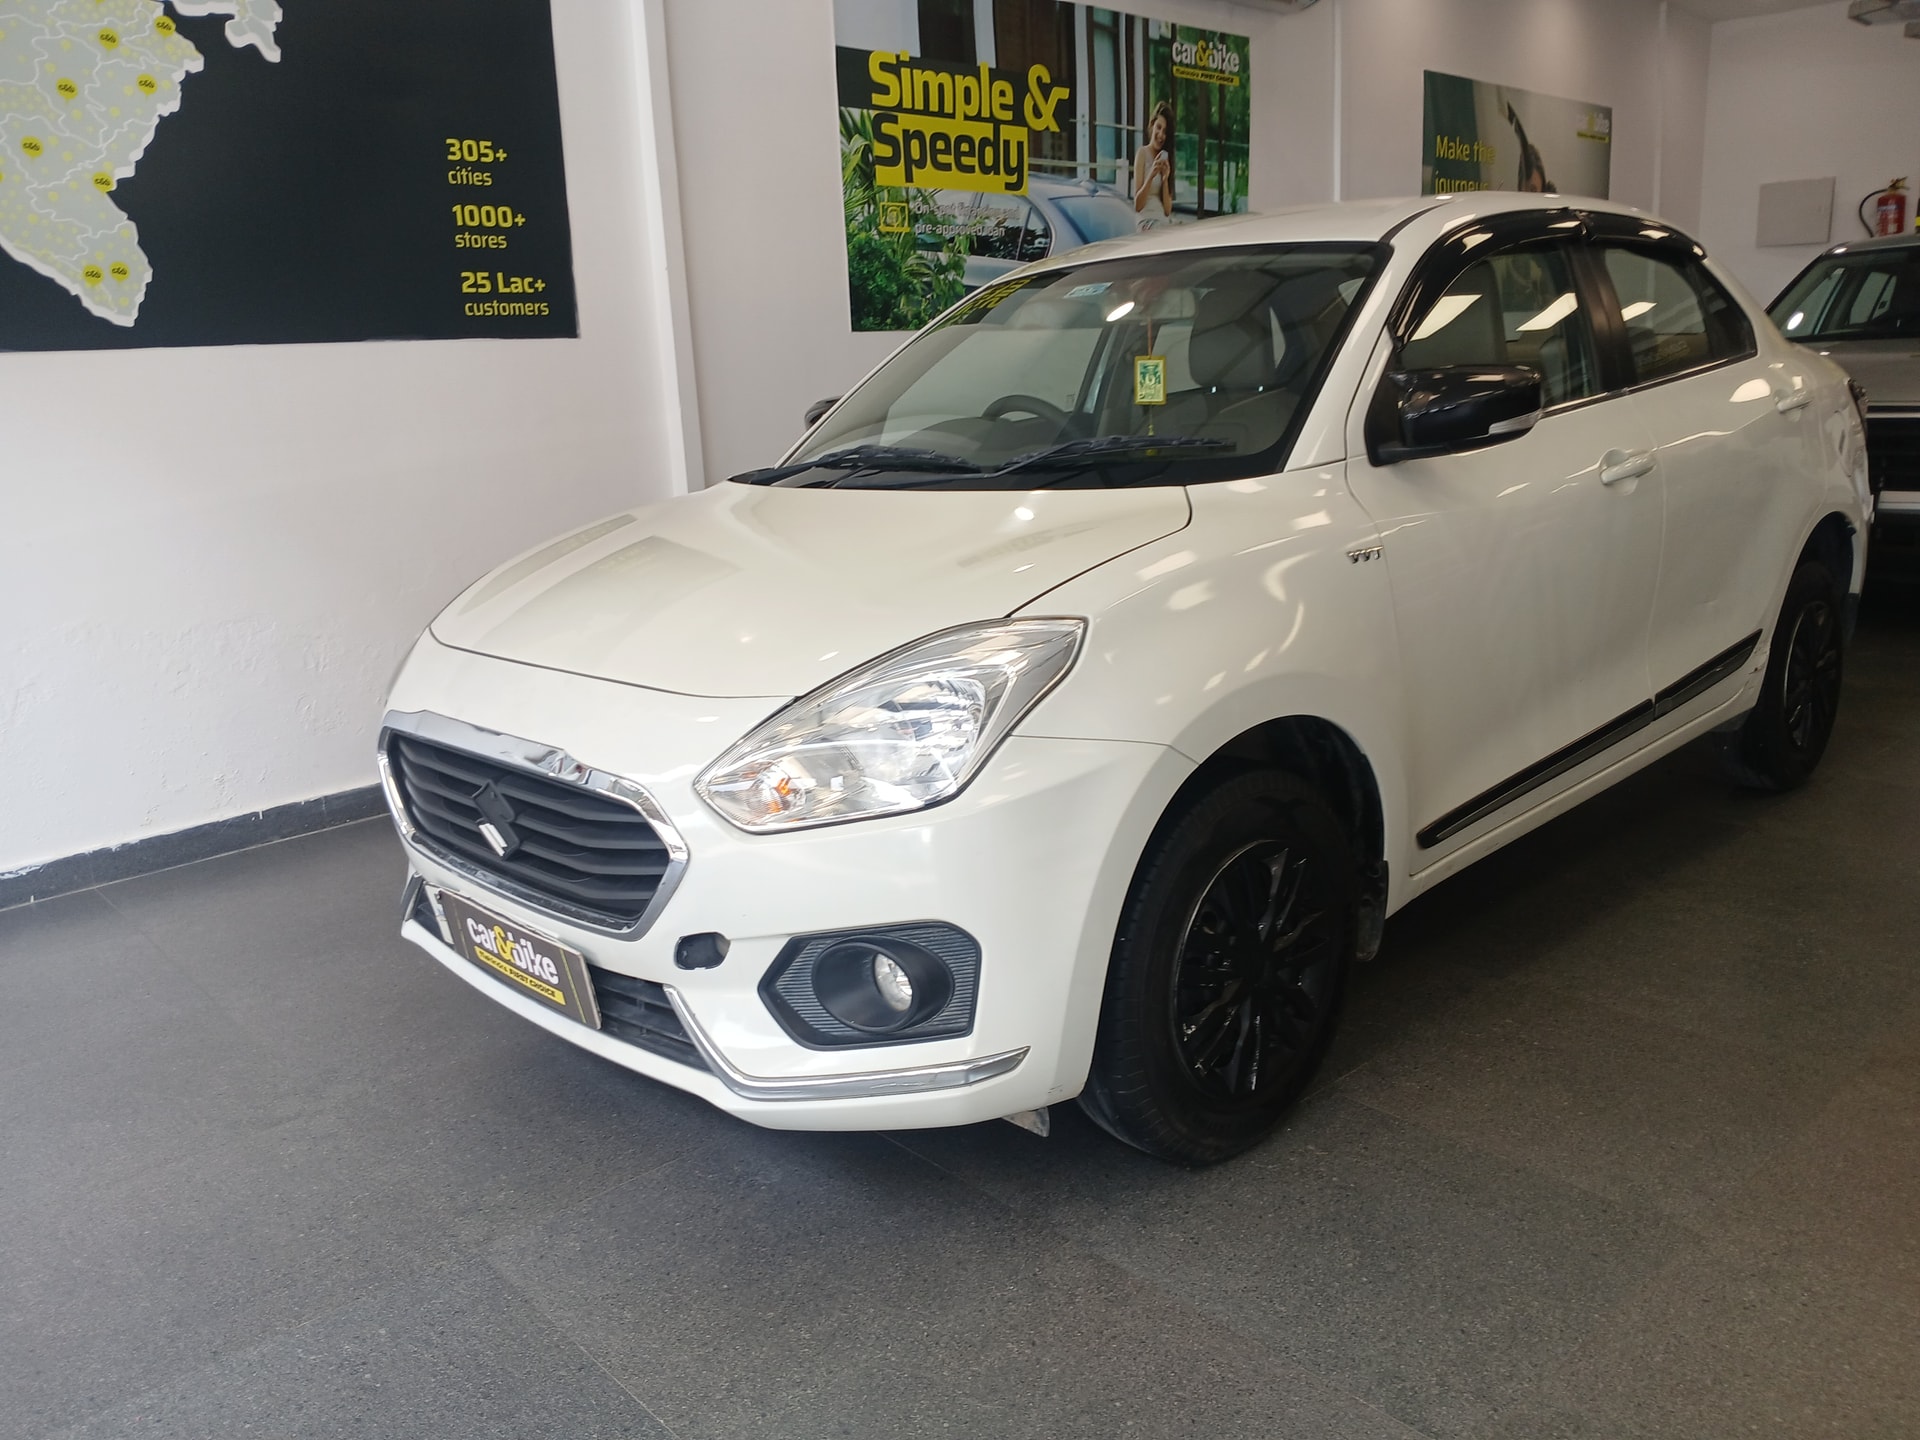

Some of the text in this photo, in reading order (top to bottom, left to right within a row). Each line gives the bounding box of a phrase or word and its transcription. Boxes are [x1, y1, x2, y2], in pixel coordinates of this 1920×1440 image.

[1172, 40, 1239, 74] car&bike
[868, 50, 1070, 132] Simple &
[445, 138, 508, 163] 305+
[873, 111, 1024, 191] Speedy
[1436, 134, 1496, 165] Make the
[447, 165, 493, 186] cities
[452, 204, 526, 228] 1000+
[454, 231, 508, 249] stores
[460, 271, 546, 293] 25 Lac+
[464, 300, 550, 316] customers
[467, 917, 559, 985] car&bike
